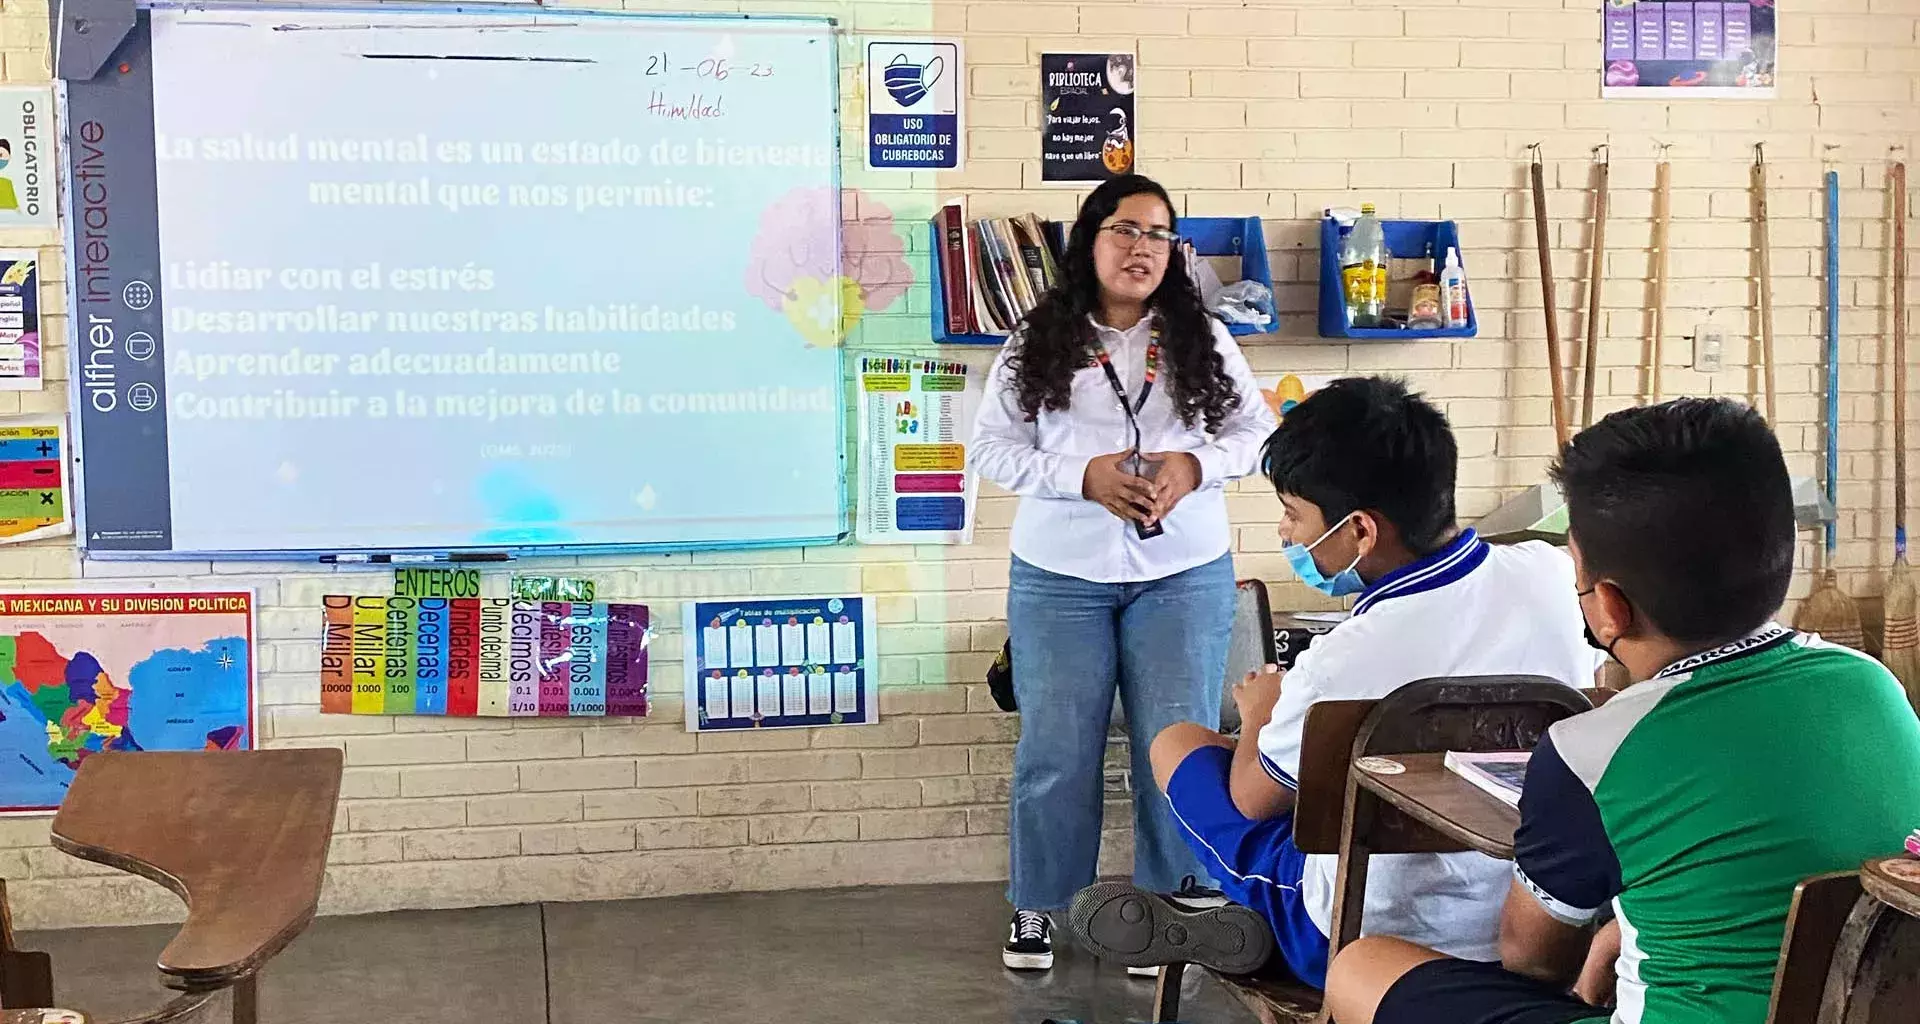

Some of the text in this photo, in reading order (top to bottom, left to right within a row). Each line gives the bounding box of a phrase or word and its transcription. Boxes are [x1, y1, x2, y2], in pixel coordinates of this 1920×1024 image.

[1049, 72, 1102, 87] BIBLIOTECA
[903, 118, 924, 130] USO
[1062, 132, 1074, 143] hay
[1074, 134, 1094, 143] mejor
[1063, 116, 1081, 125] viajar
[158, 132, 194, 161] La
[202, 131, 298, 163] salud
[307, 132, 428, 164] mental
[436, 138, 472, 164] es
[481, 138, 523, 165] un
[532, 136, 642, 166] estado
[651, 137, 688, 166] de
[874, 133, 952, 145] OBLIGATORIO DE
[882, 149, 945, 161] CUBREBOCAS
[22, 101, 40, 215] OBLIGATORIO
[1061, 153, 1074, 162] que
[1075, 152, 1083, 160] un
[309, 175, 715, 213] mental que nos permite:
[75, 120, 117, 412] alfher interactive
[170, 260, 494, 292] Lidiar con el estrés
[172, 303, 736, 334] Desarrollar nuestras habilidades
[172, 347, 621, 382] Aprender adecuadamente
[174, 388, 360, 420] Contribuir
[368, 394, 388, 419] a
[395, 388, 427, 419] la
[436, 387, 556, 423] mejora
[565, 387, 606, 416] de
[611, 387, 643, 415] la
[32, 428, 54, 438] Signo
[394, 568, 480, 597] ENTEROS
[10, 598, 84, 613] MEXICANA
[88, 598, 97, 612] Y
[101, 598, 120, 612] SU
[321, 623, 351, 678] Millar
[353, 595, 385, 678] U. Millar
[385, 596, 415, 679] Centenas
[417, 597, 448, 679] Decenas
[448, 597, 480, 680] Unidades
[480, 597, 510, 683] Punto decimal
[510, 602, 541, 682] décimos
[570, 602, 600, 683] mésimos
[1660, 628, 1783, 676] MARCIANO
[322, 684, 352, 693] 10000
[357, 684, 381, 693] 1000
[391, 684, 410, 694] 100
[426, 685, 438, 694] 10
[460, 685, 466, 694] 1
[516, 686, 531, 695] 0.1
[543, 686, 564, 696] 0.01
[574, 687, 600, 696] 0.001
[512, 703, 535, 712] 1/10
[540, 703, 568, 712] 1/100
[570, 702, 604, 712] 1/1000
